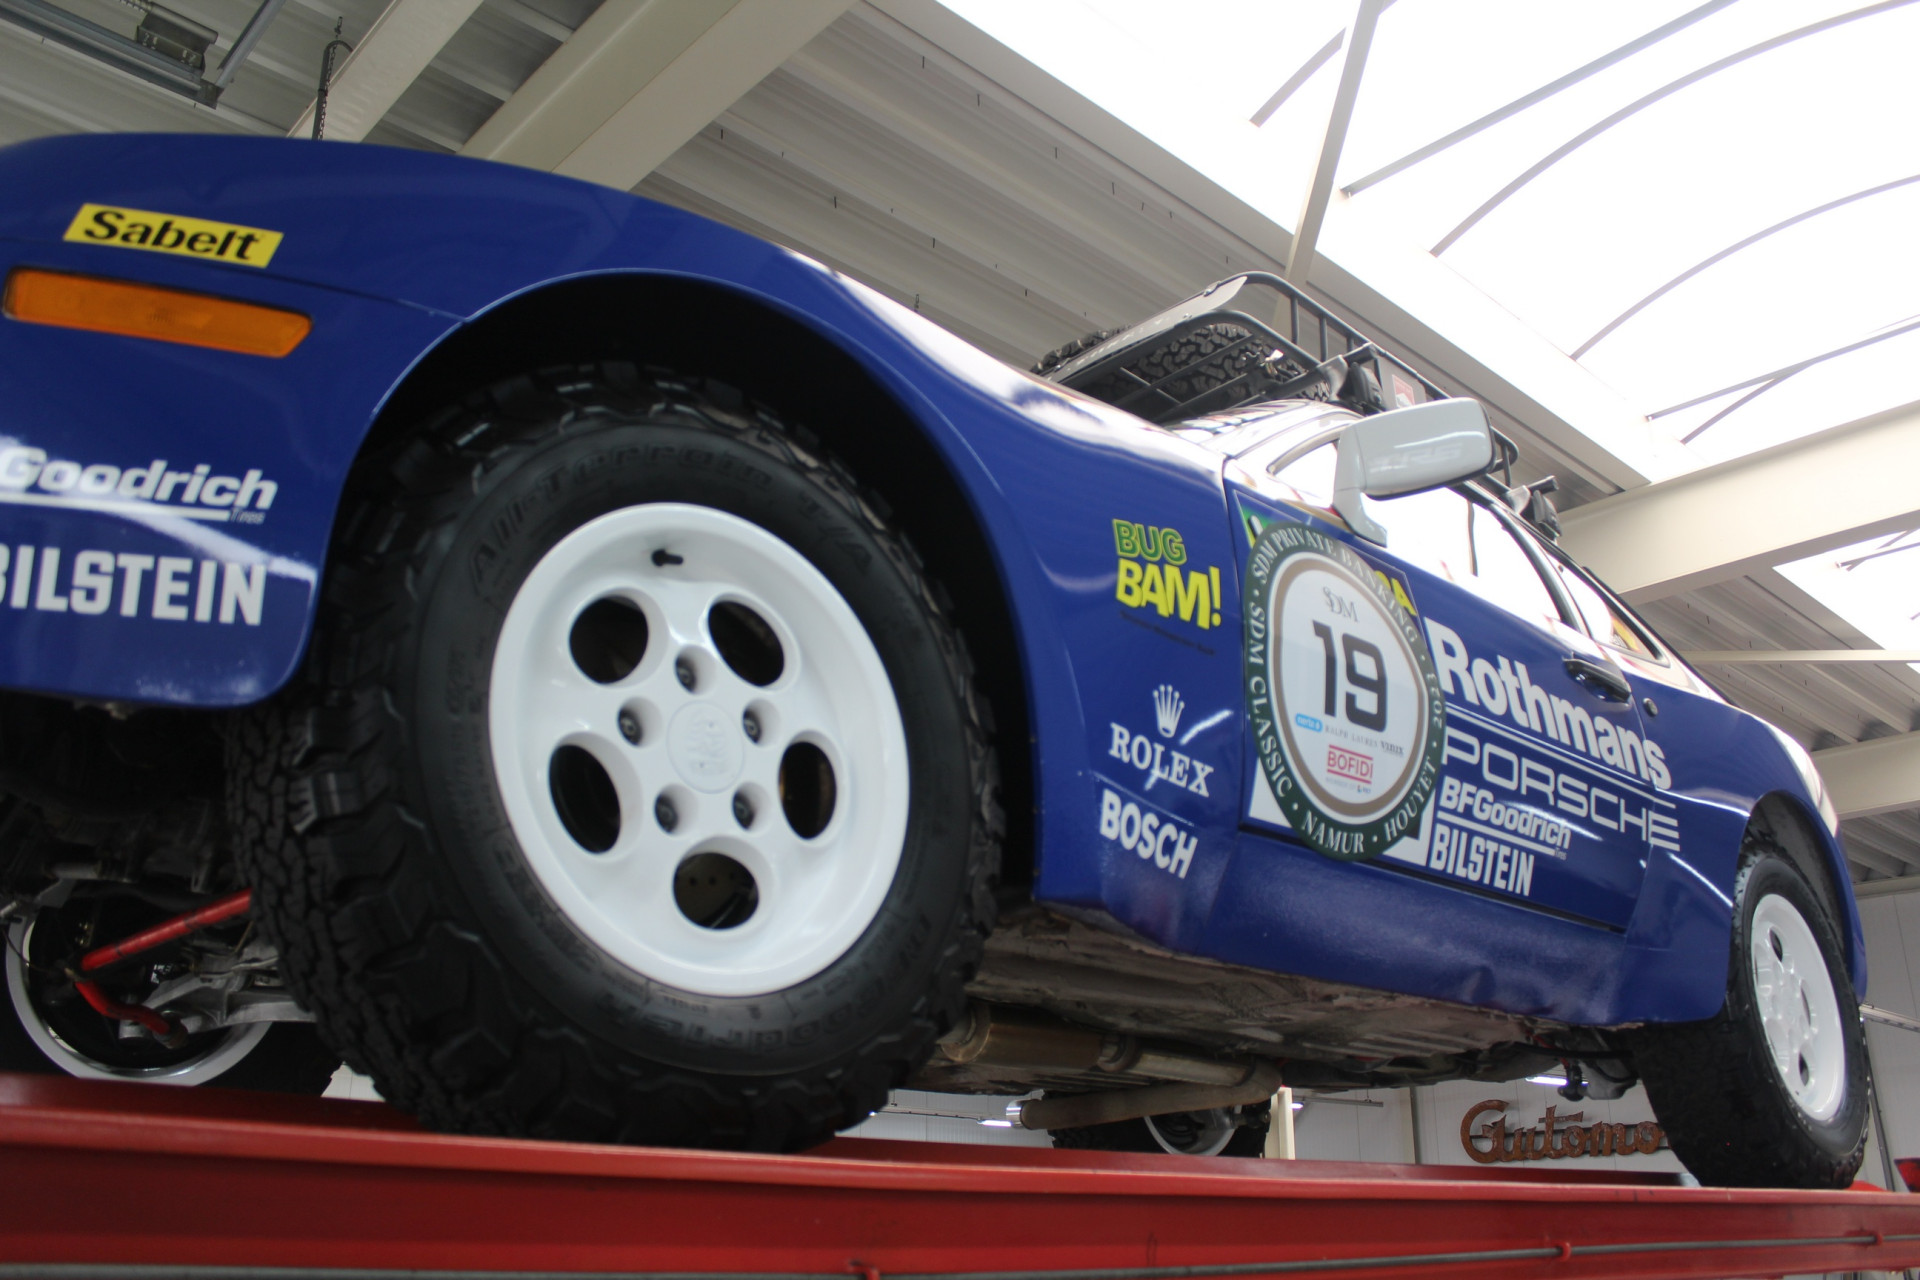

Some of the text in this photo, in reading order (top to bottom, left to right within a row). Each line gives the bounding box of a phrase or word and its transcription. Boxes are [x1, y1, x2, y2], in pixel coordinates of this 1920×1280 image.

[84, 209, 260, 261] Sabelt
[1112, 518, 1188, 566] BUG
[1115, 557, 1222, 630] BAM!
[1252, 539, 1278, 585] SDM
[1270, 527, 1337, 558] PRIVATE
[1341, 546, 1419, 643] BANKING
[1250, 601, 1293, 799] SDM CLASSIC
[1312, 619, 1388, 734] 19
[1424, 616, 1672, 790] Rothmans
[1109, 721, 1215, 798] ROLEX
[1327, 750, 1374, 779] BOFIDI
[1441, 726, 1681, 852] PORSCHE
[1100, 788, 1199, 880] BOSCH
[1301, 755, 1438, 854] NAMUR HOUYET
[1438, 775, 1572, 850] BFGoodrich
[1429, 823, 1535, 897] BILSTEIN
